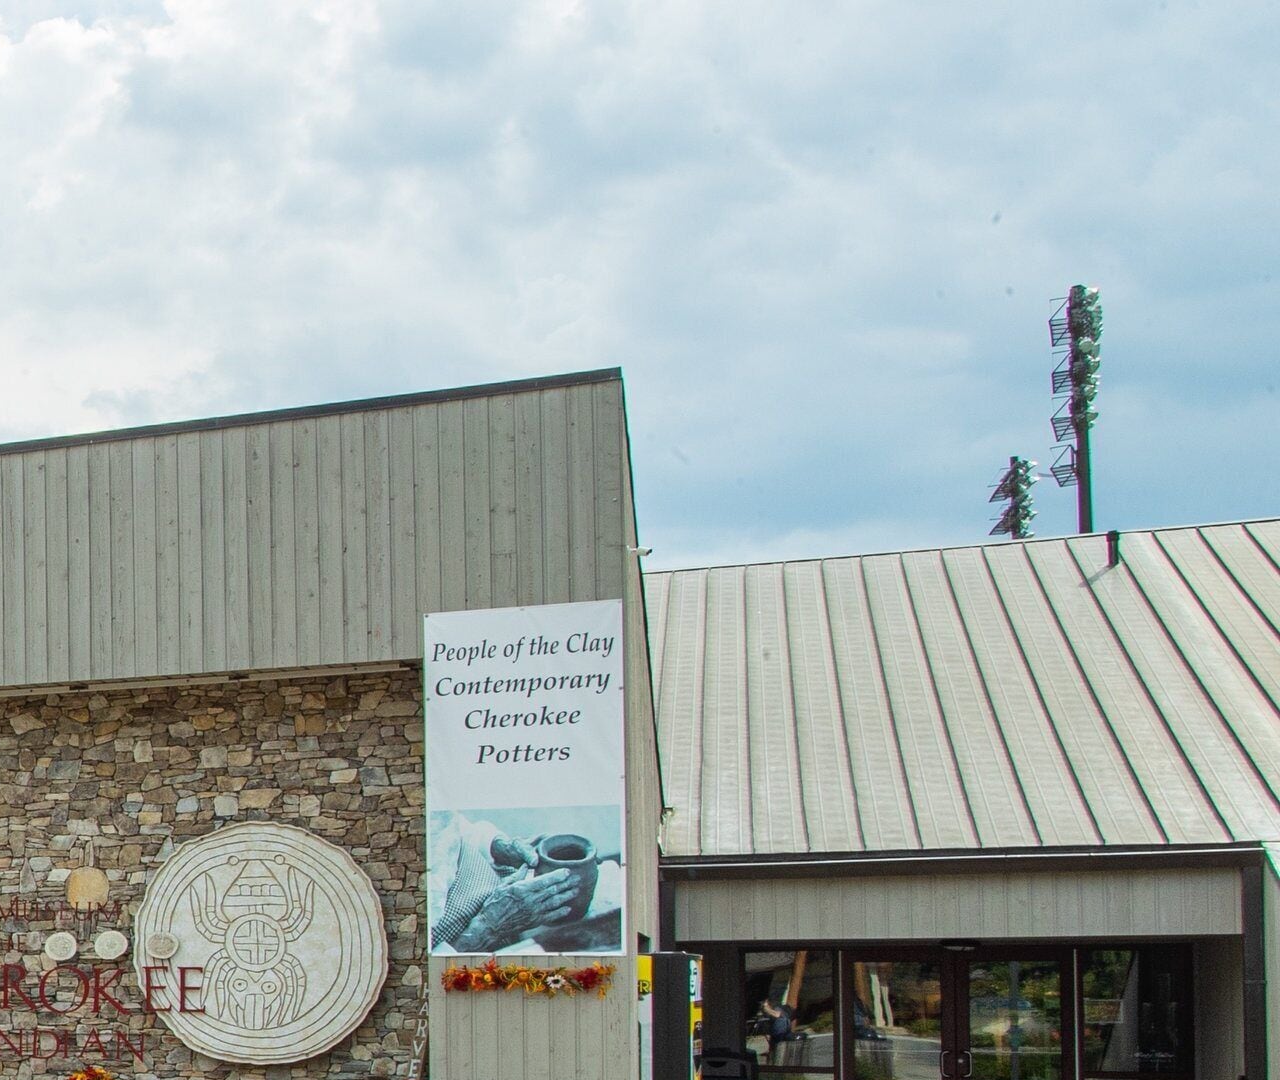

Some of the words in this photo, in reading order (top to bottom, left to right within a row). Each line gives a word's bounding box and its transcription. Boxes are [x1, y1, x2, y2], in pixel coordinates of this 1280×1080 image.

[432, 639, 497, 667] People
[503, 636, 526, 664] of
[529, 635, 559, 656] the
[566, 632, 615, 658] Clay
[435, 672, 611, 698] Contemporary
[464, 705, 581, 730] Cherokee
[476, 743, 571, 764] Potters
